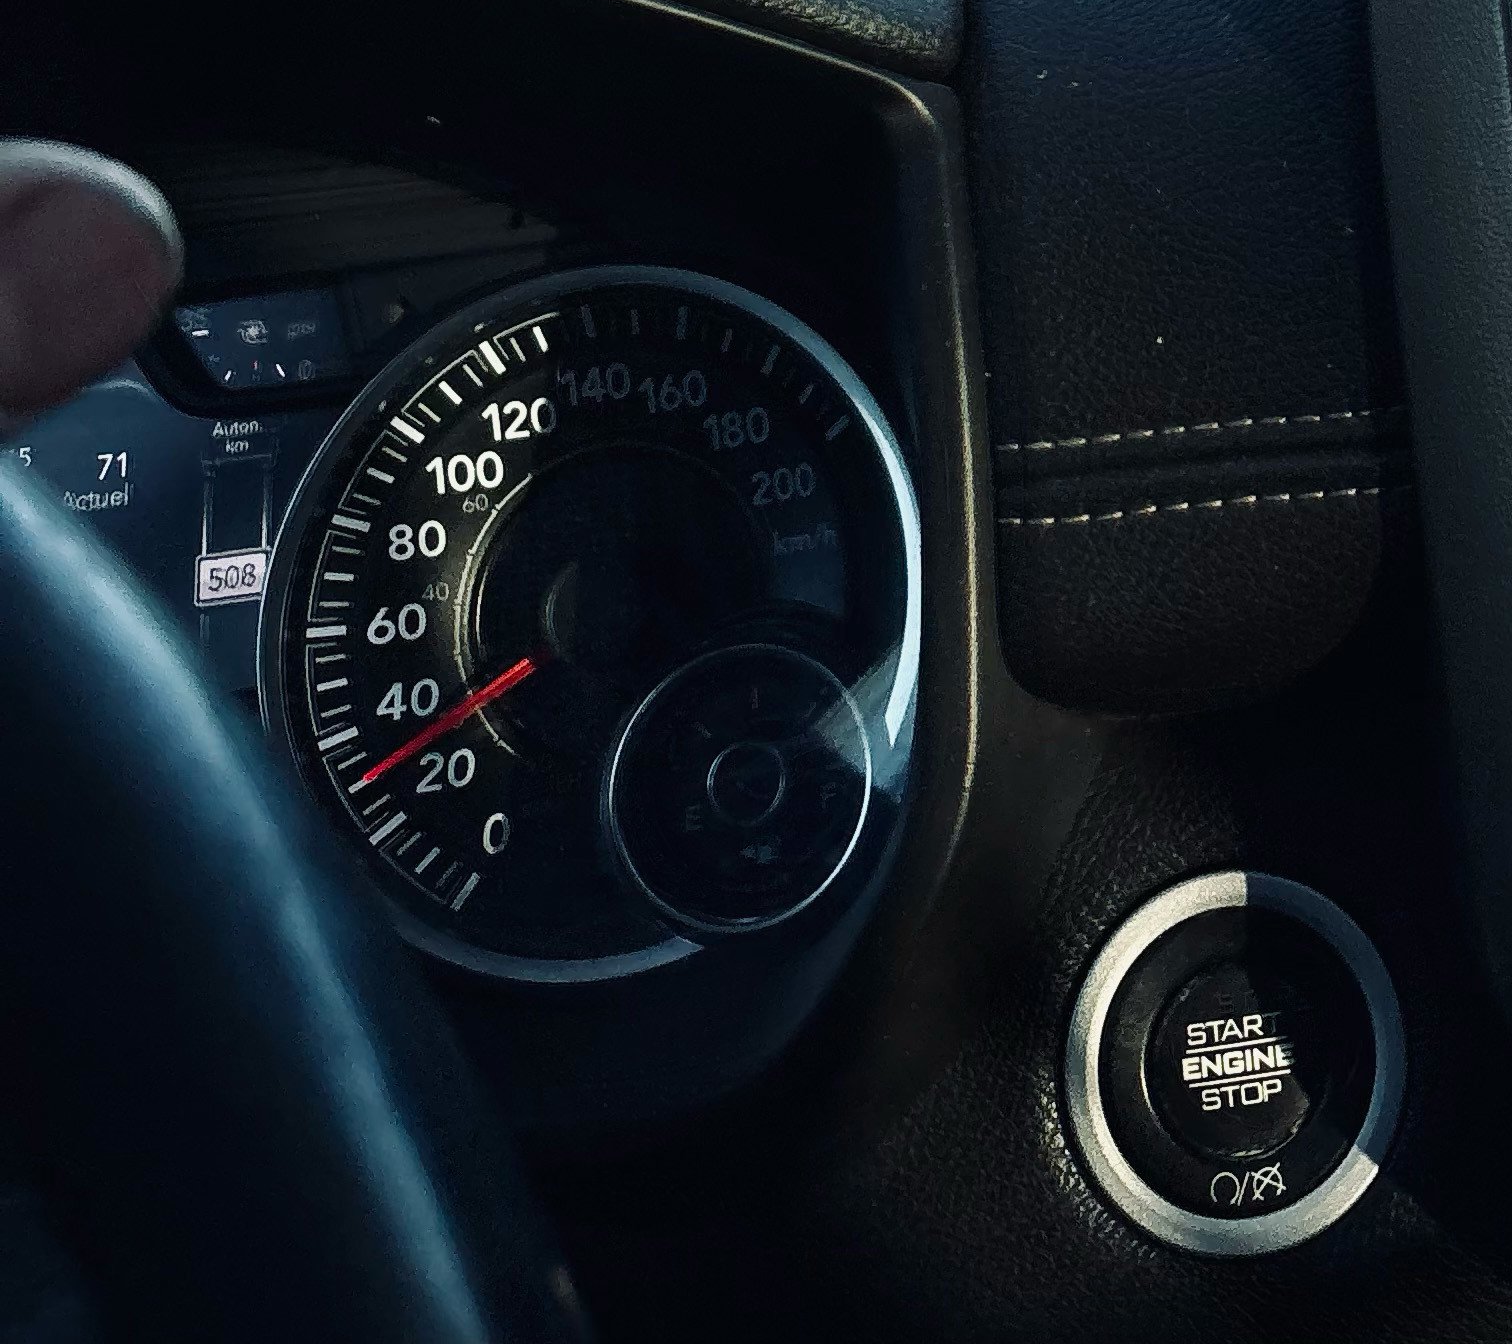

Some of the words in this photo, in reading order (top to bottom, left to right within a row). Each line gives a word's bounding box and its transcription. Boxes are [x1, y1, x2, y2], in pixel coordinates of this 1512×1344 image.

[555, 362, 632, 407] 140
[636, 369, 708, 414] 160
[481, 397, 557, 442] 120
[702, 406, 770, 452] 180
[97, 451, 128, 481] 71
[425, 450, 504, 495] 100
[751, 461, 817, 506] 200
[462, 493, 489, 514] 60
[388, 519, 447, 561] 80
[208, 561, 257, 592] 508
[421, 581, 450, 602] 40
[366, 603, 427, 645] 60
[376, 678, 440, 721] 40
[416, 748, 476, 794] 20
[483, 812, 511, 855] 0
[1201, 1078, 1282, 1111] STOP
